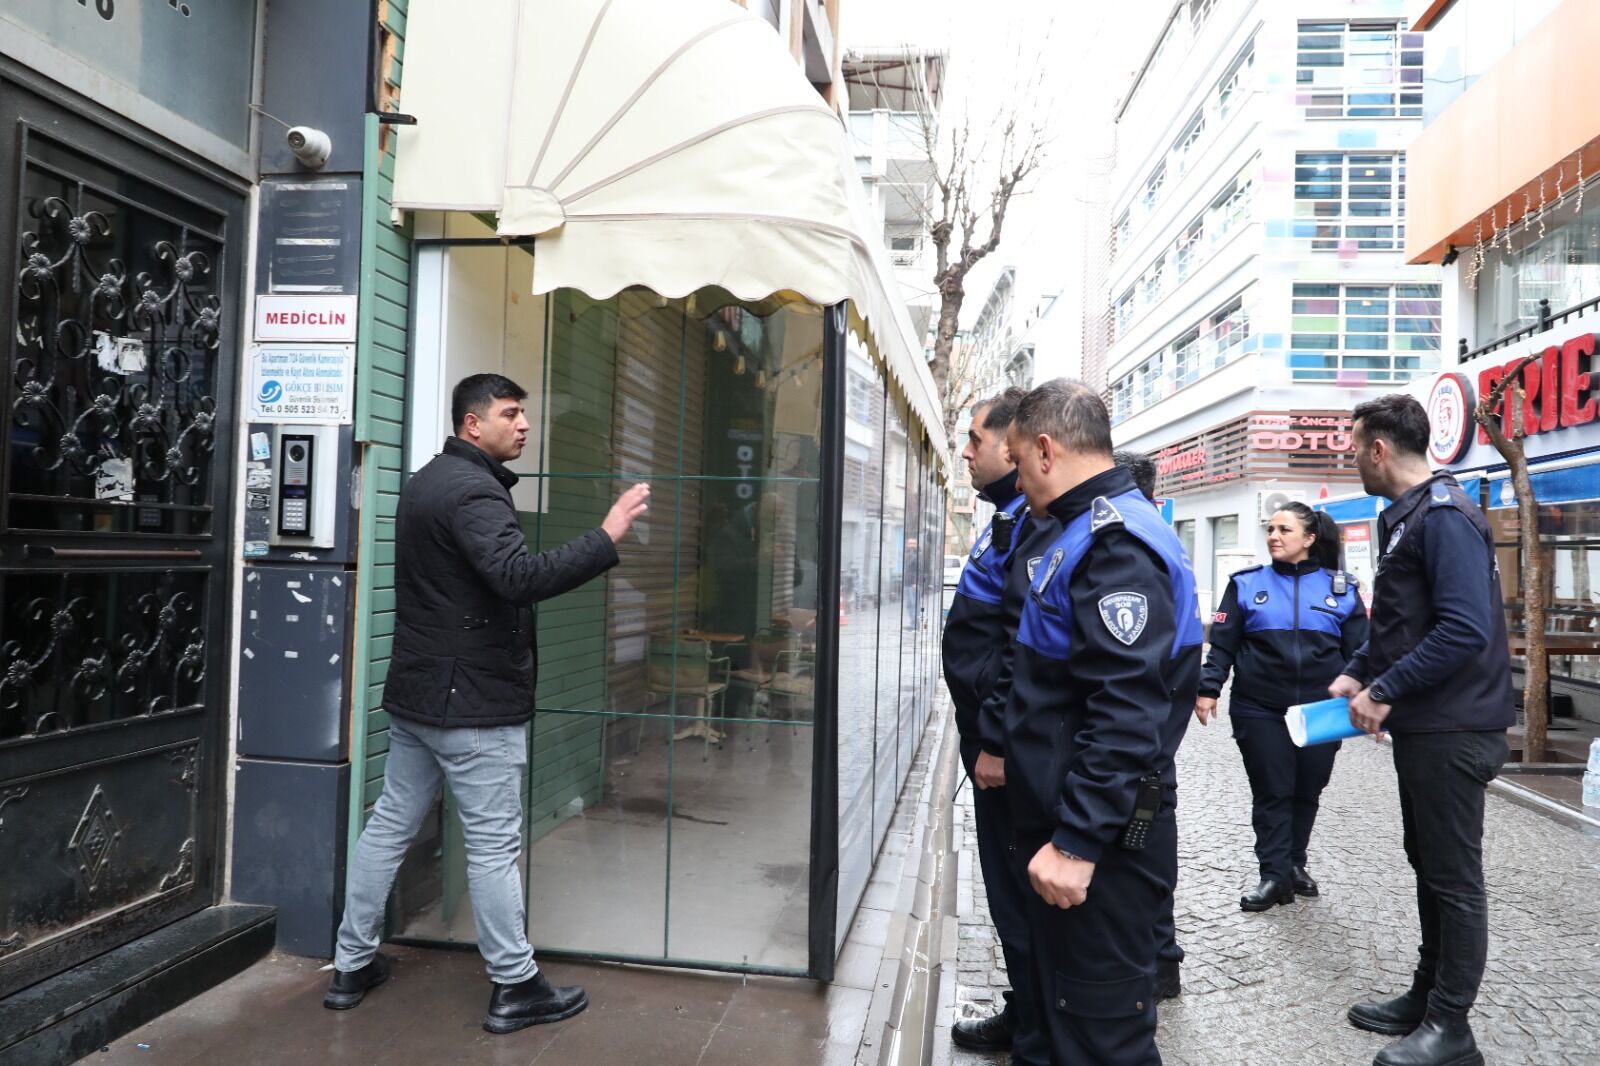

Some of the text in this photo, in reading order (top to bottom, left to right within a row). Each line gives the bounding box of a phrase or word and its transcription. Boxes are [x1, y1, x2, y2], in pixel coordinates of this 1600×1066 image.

[266, 310, 345, 325] MEDİCLİN
[285, 381, 312, 394] GÖKÇE
[1478, 333, 1600, 446] FRIE
[277, 405, 282, 413] 0
[284, 405, 299, 413] 505
[301, 405, 316, 413] 523
[330, 405, 339, 414] 73
